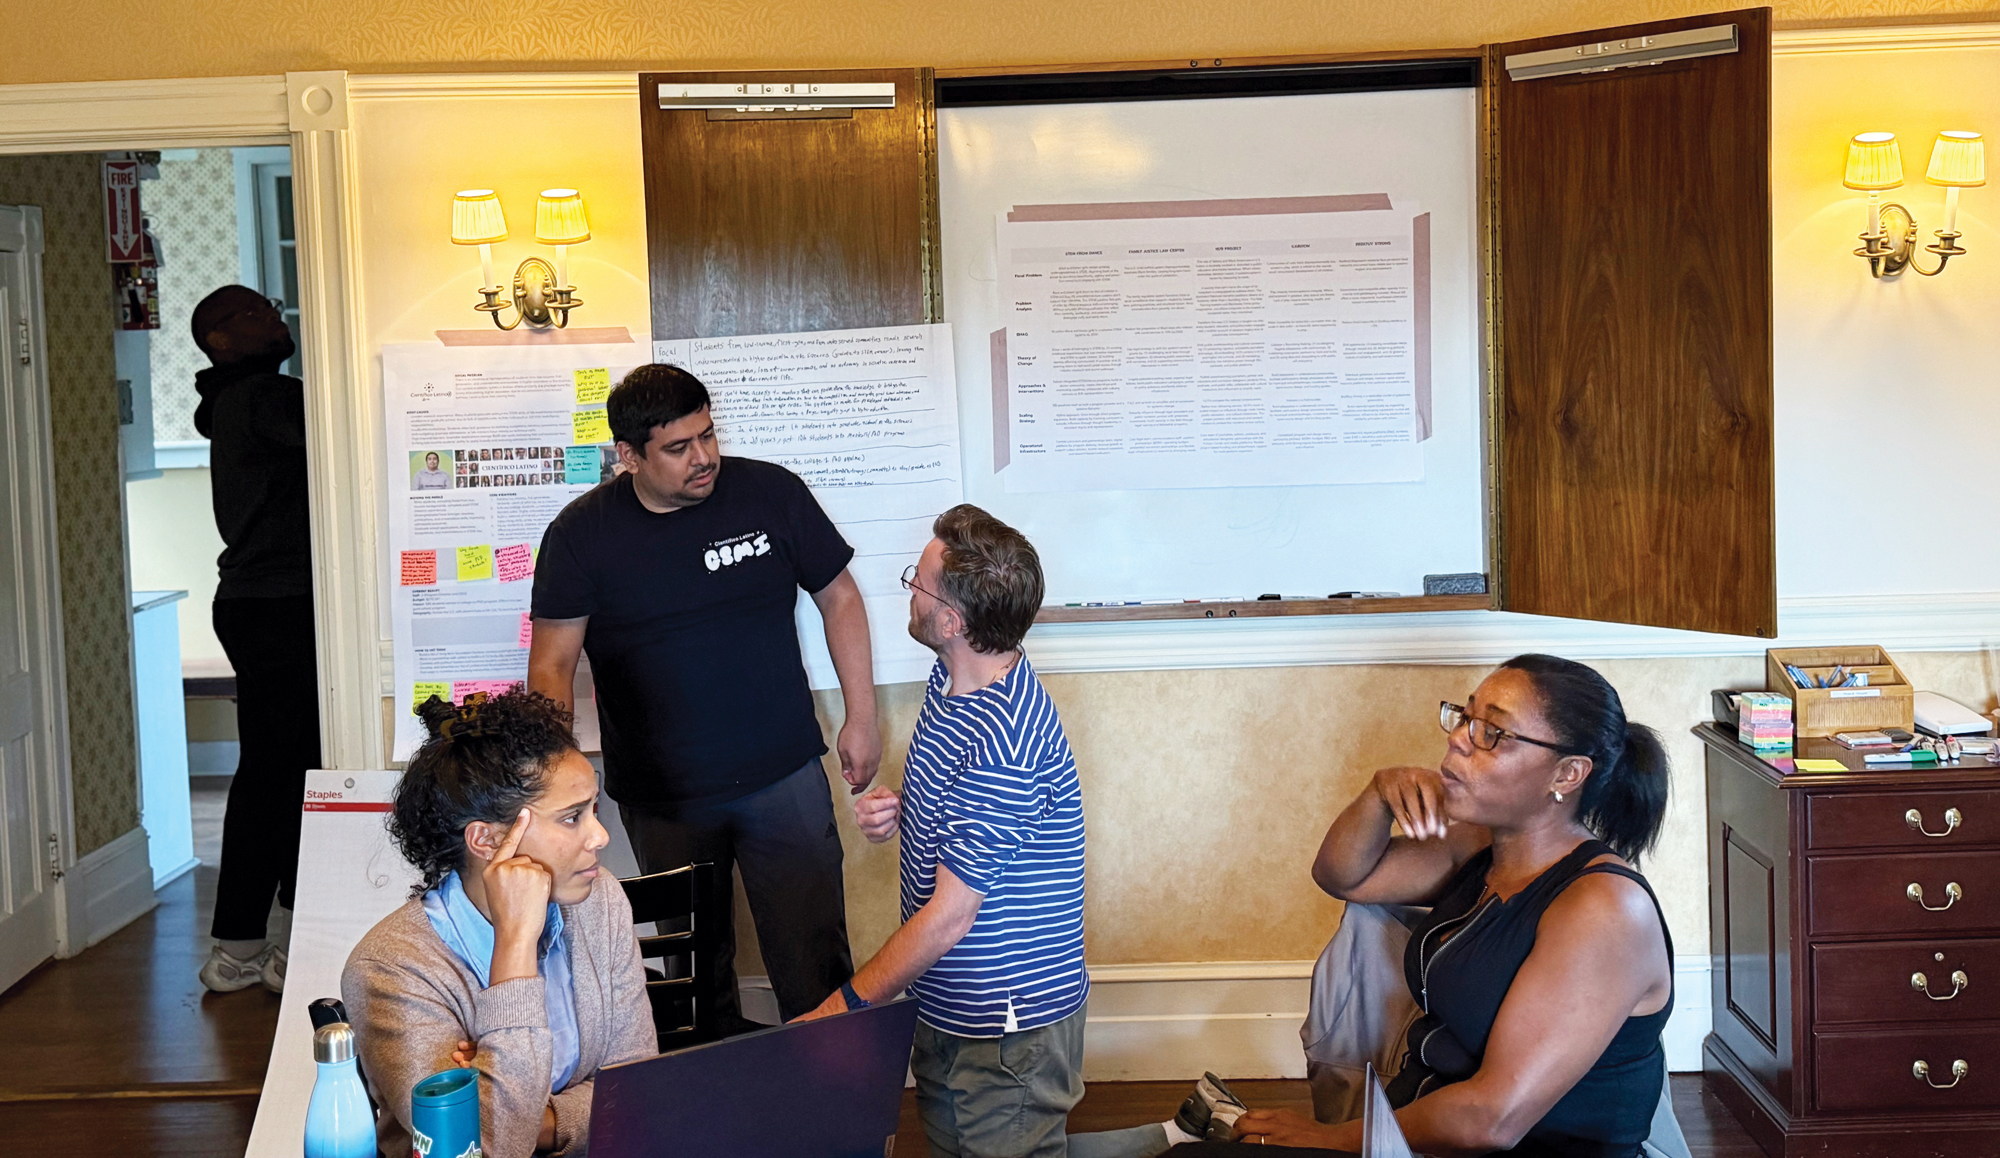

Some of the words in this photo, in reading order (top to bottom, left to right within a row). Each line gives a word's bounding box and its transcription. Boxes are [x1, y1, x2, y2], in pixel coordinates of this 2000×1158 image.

[111, 172, 133, 186] FIRE
[694, 341, 724, 353] Students
[306, 790, 343, 800] Staples
